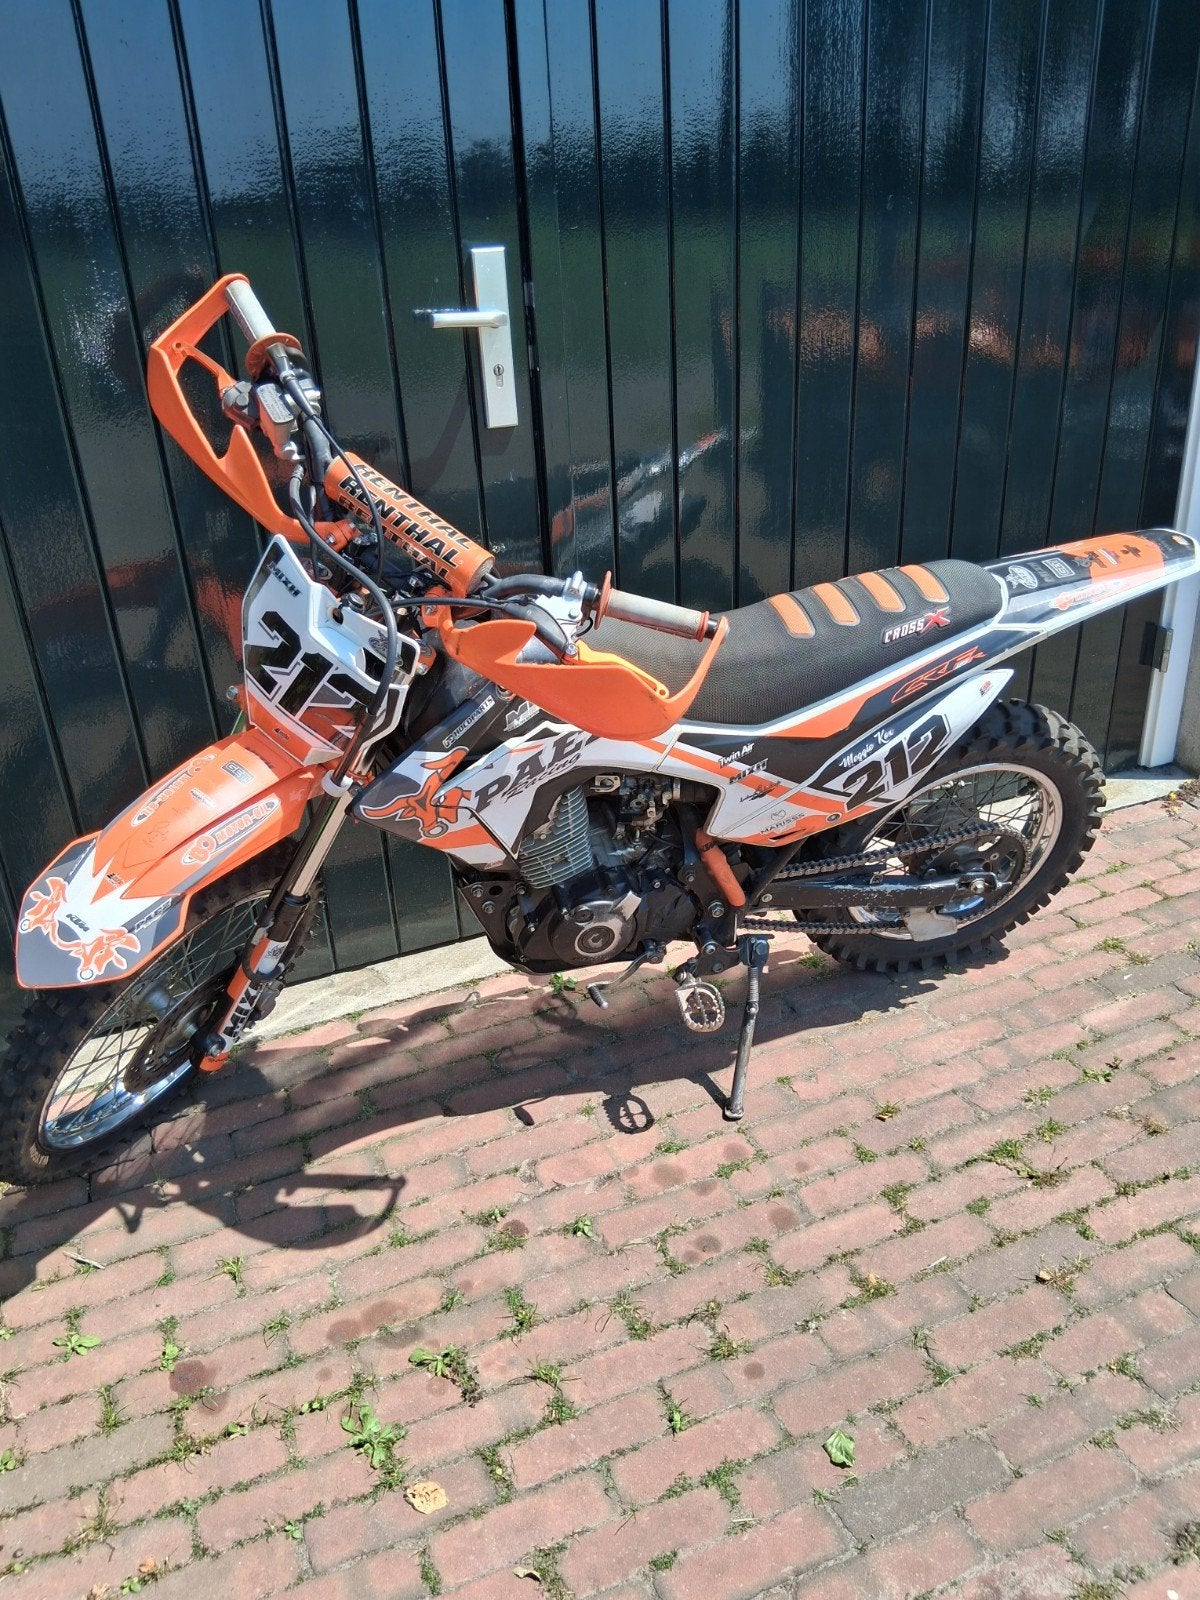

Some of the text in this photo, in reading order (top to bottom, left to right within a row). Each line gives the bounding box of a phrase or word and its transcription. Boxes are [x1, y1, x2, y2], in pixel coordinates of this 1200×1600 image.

[338, 475, 464, 569] RENTHAL
[719, 742, 755, 768] Twin Air
[842, 714, 950, 813] 212
[215, 802, 273, 845] MOTOR-OIL
